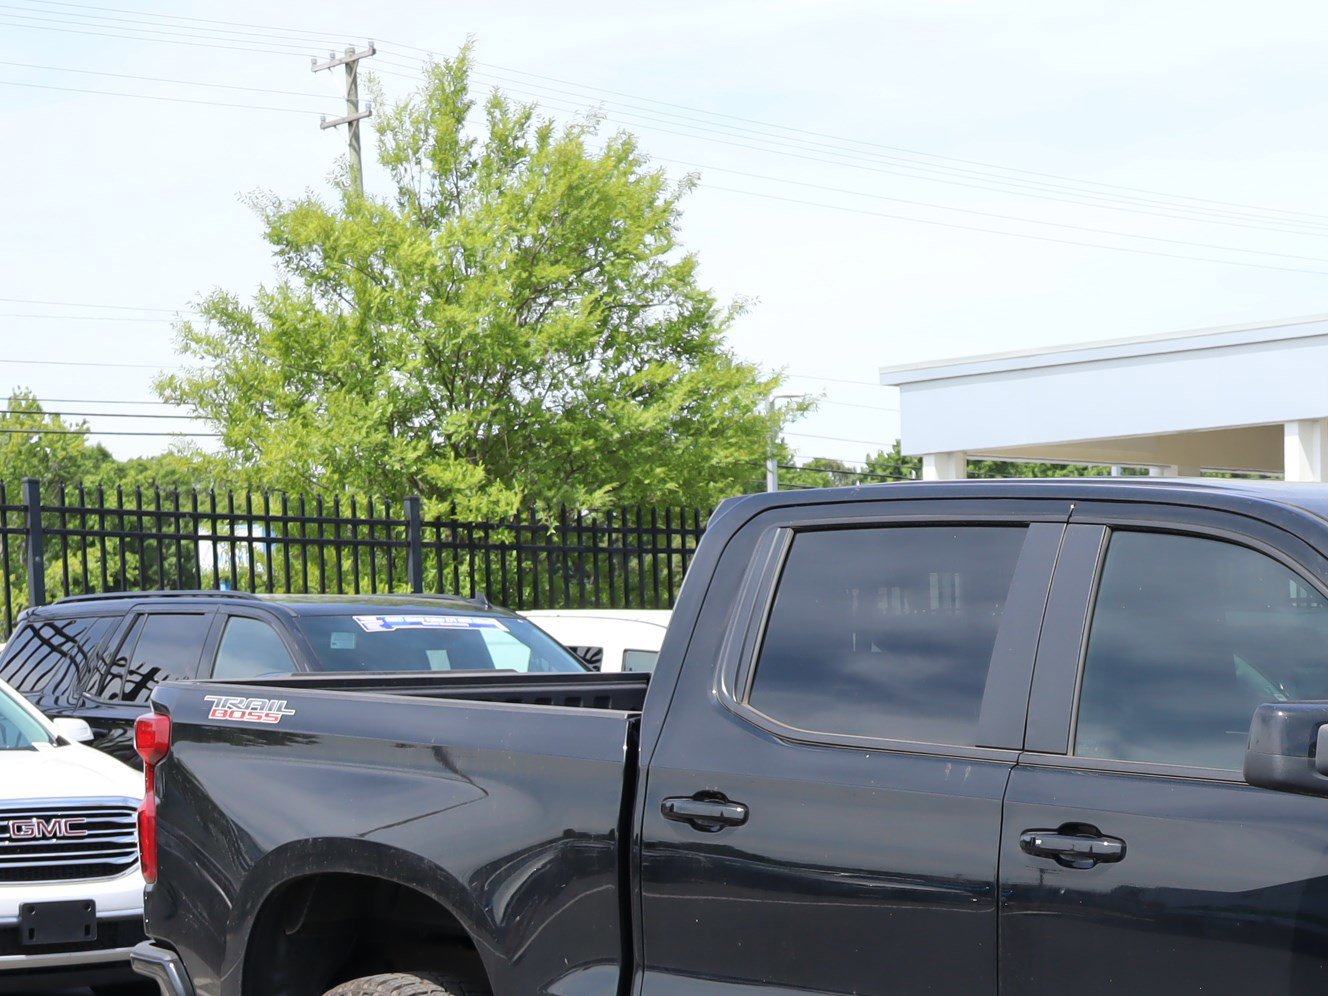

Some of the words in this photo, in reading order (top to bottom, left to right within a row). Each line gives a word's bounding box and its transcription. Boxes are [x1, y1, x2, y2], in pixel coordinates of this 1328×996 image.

[204, 695, 296, 716] TRAIL
[208, 707, 282, 724] BOSS
[9, 818, 88, 838] GMC
